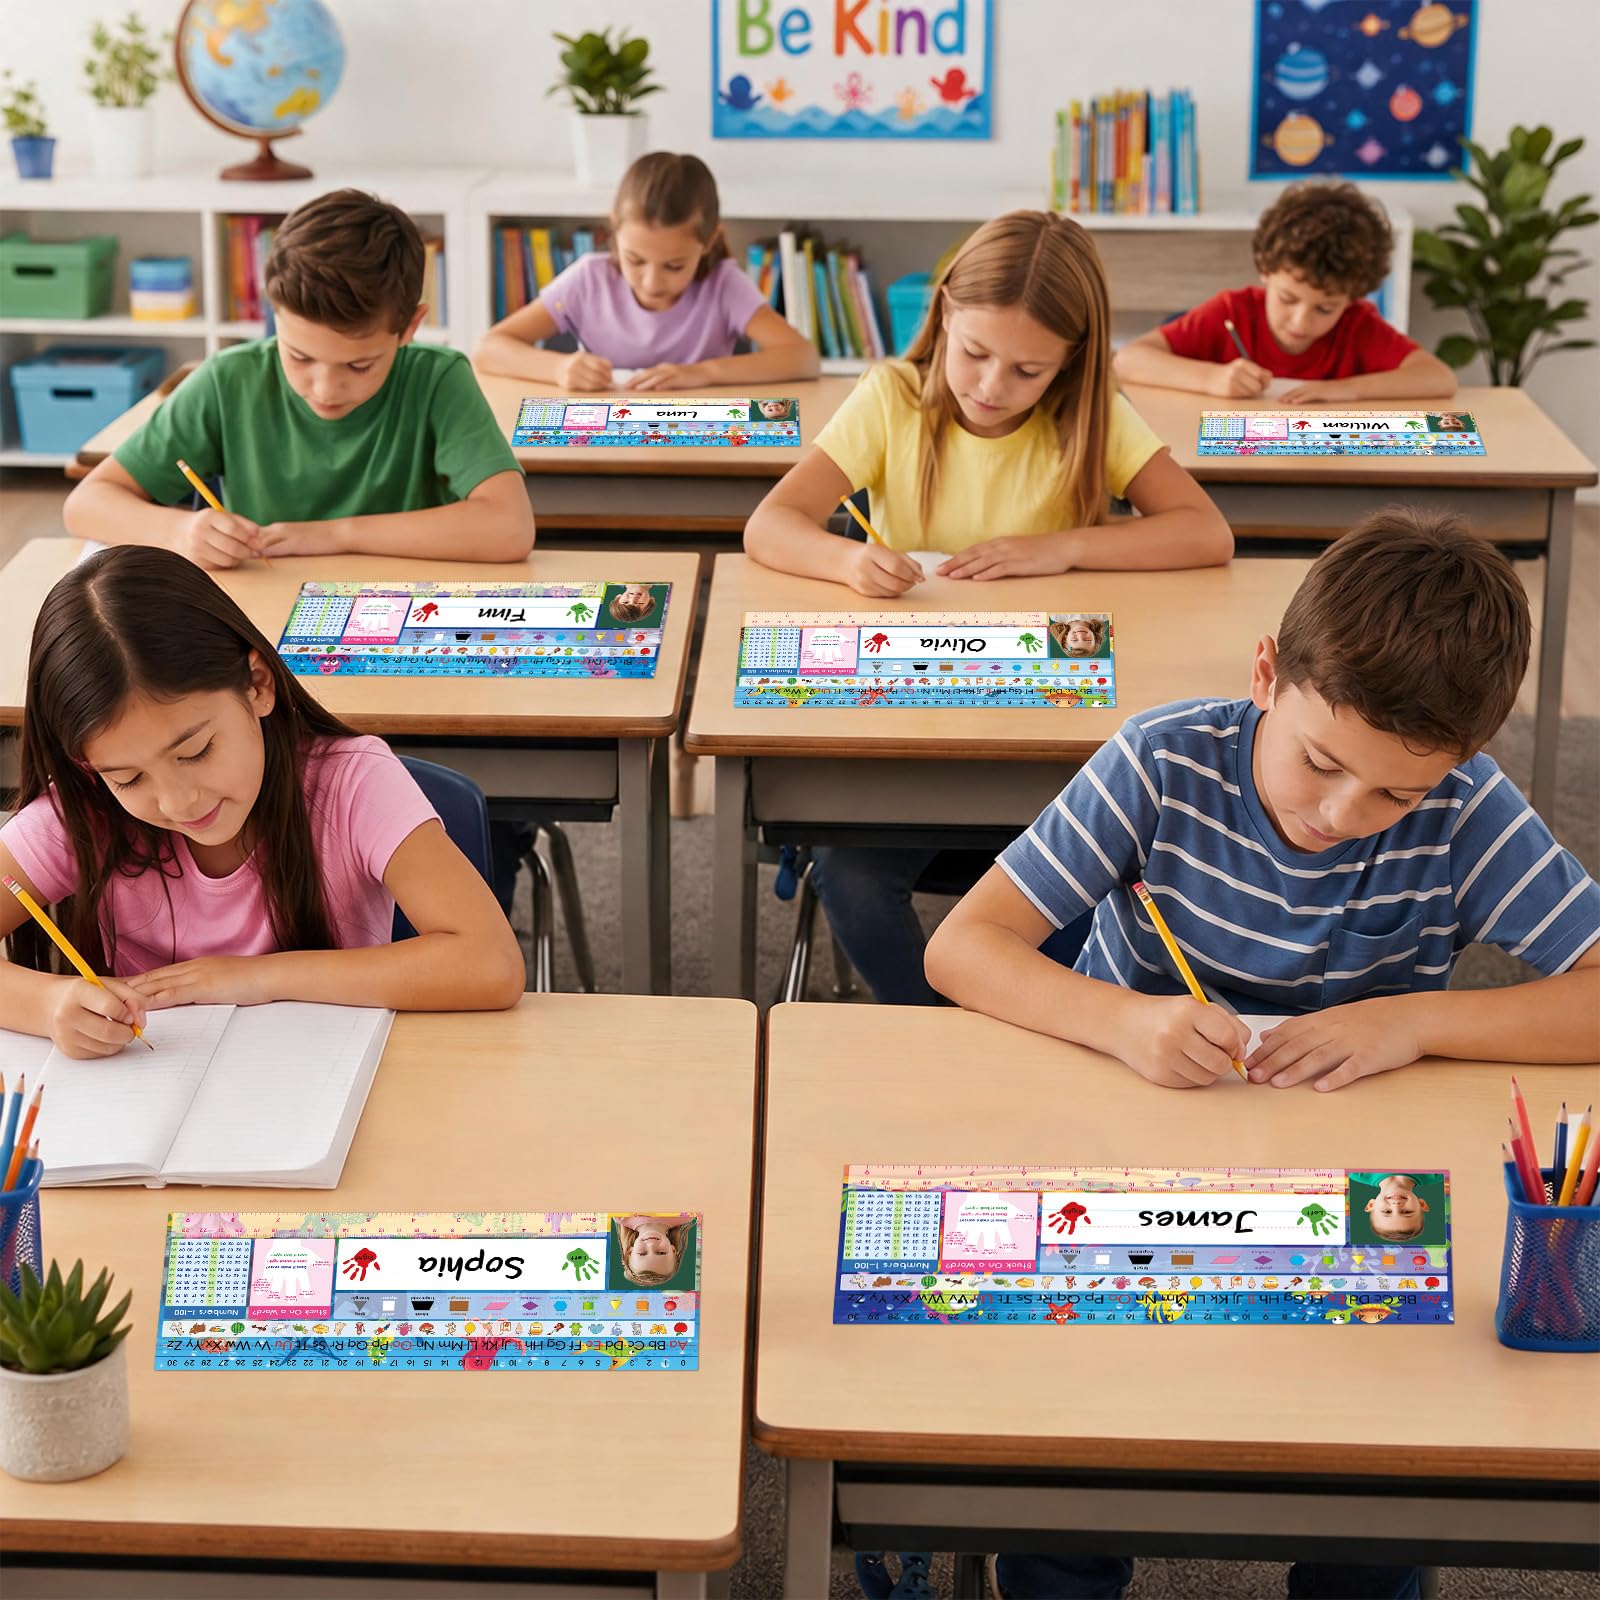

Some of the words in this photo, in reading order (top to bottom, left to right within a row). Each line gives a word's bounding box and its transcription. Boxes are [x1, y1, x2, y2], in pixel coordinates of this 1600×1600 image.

[737, 0, 812, 56] Be
[833, 0, 966, 56] Kind
[656, 411, 698, 419] Luna
[1323, 422, 1390, 430] William
[478, 608, 526, 622] Finn
[920, 638, 986, 653] Olivia
[1139, 1210, 1257, 1233] James
[418, 1249, 524, 1281] Sophia
[167, 1340, 182, 1350] Zz
[186, 1338, 202, 1350] Yy
[205, 1340, 221, 1350] Xx
[227, 1340, 250, 1350] Ww
[255, 1340, 271, 1350] Vv
[296, 1340, 308, 1350] Tt
[313, 1340, 326, 1350] Ss
[330, 1340, 343, 1350] Rr
[348, 1338, 368, 1350] Qq
[372, 1338, 389, 1350] Pp
[416, 1340, 434, 1350] Nn
[439, 1340, 463, 1350] Mm
[468, 1340, 477, 1350] Ll
[482, 1340, 497, 1350] Kk
[501, 1338, 511, 1350] Jj
[526, 1340, 543, 1350] Hh
[548, 1338, 566, 1350] Gg
[570, 1340, 581, 1350] Ff
[606, 1340, 623, 1350] Dd
[628, 1340, 644, 1350] Cc
[648, 1340, 666, 1350] Bb
